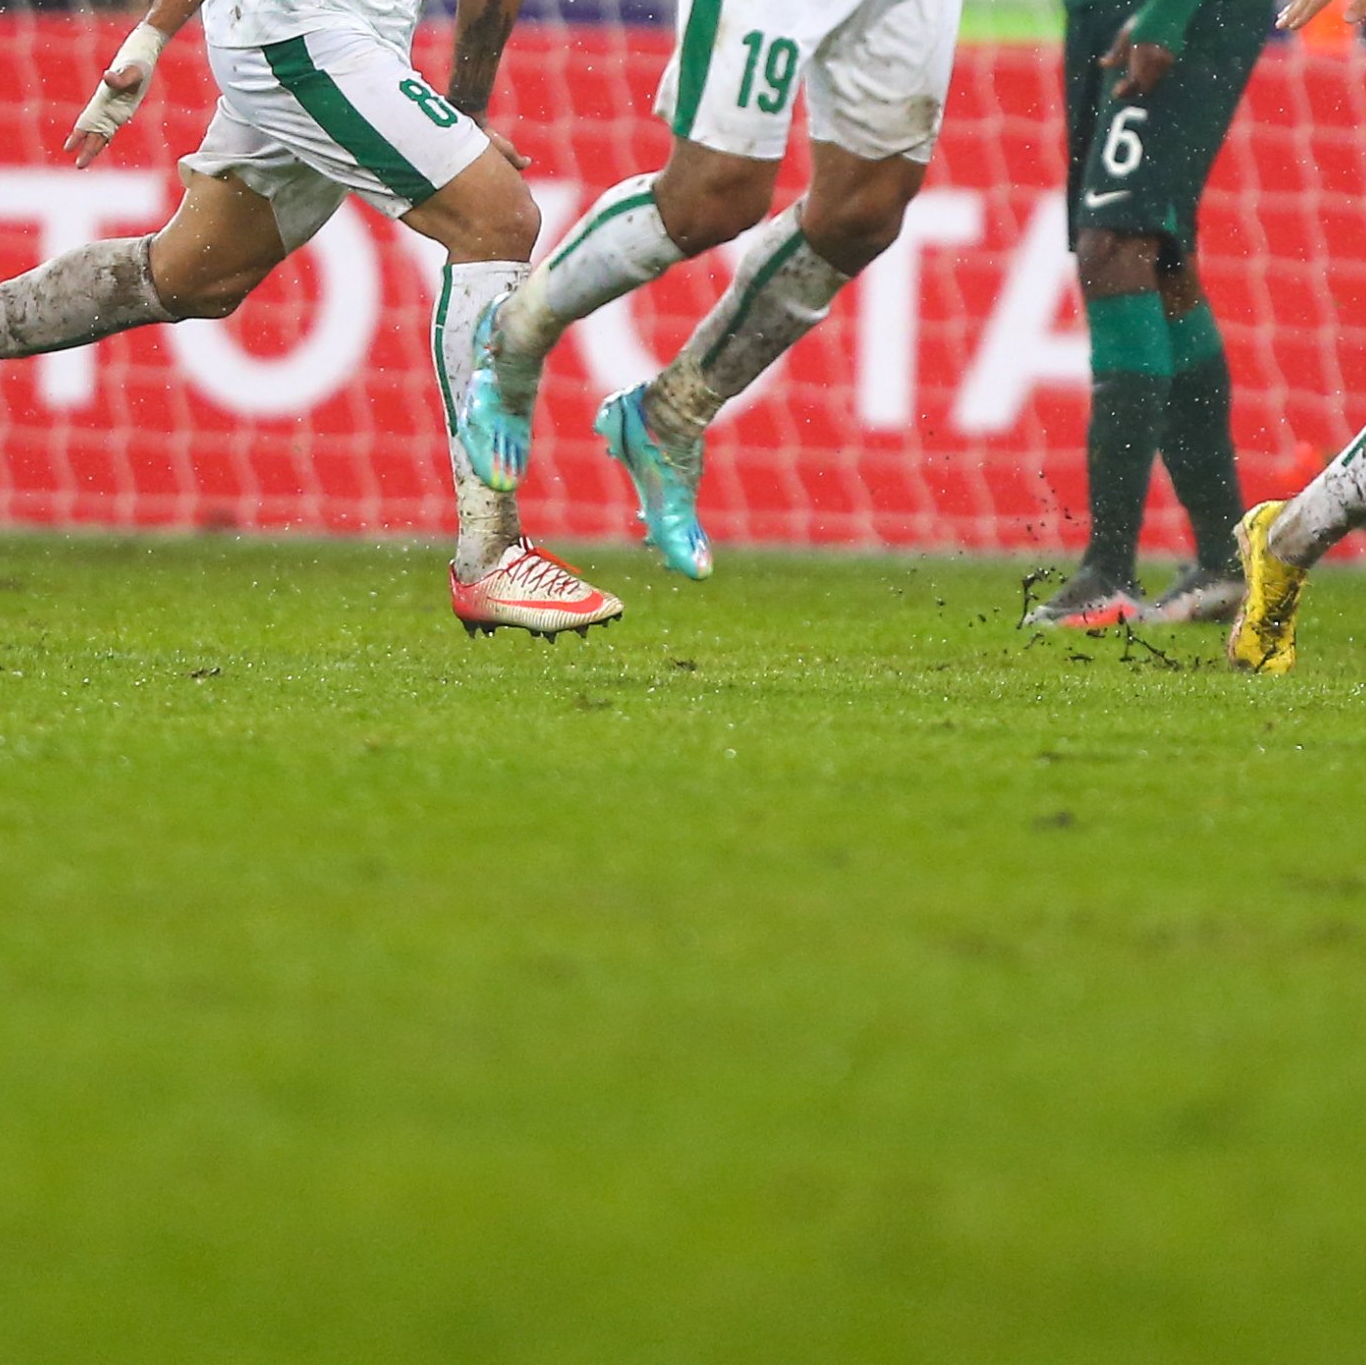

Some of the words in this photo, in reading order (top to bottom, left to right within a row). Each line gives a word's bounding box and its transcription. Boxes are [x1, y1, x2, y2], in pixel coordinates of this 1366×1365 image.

[399, 78, 458, 128] 8
[737, 29, 799, 114] 19
[1103, 106, 1147, 177] 6
